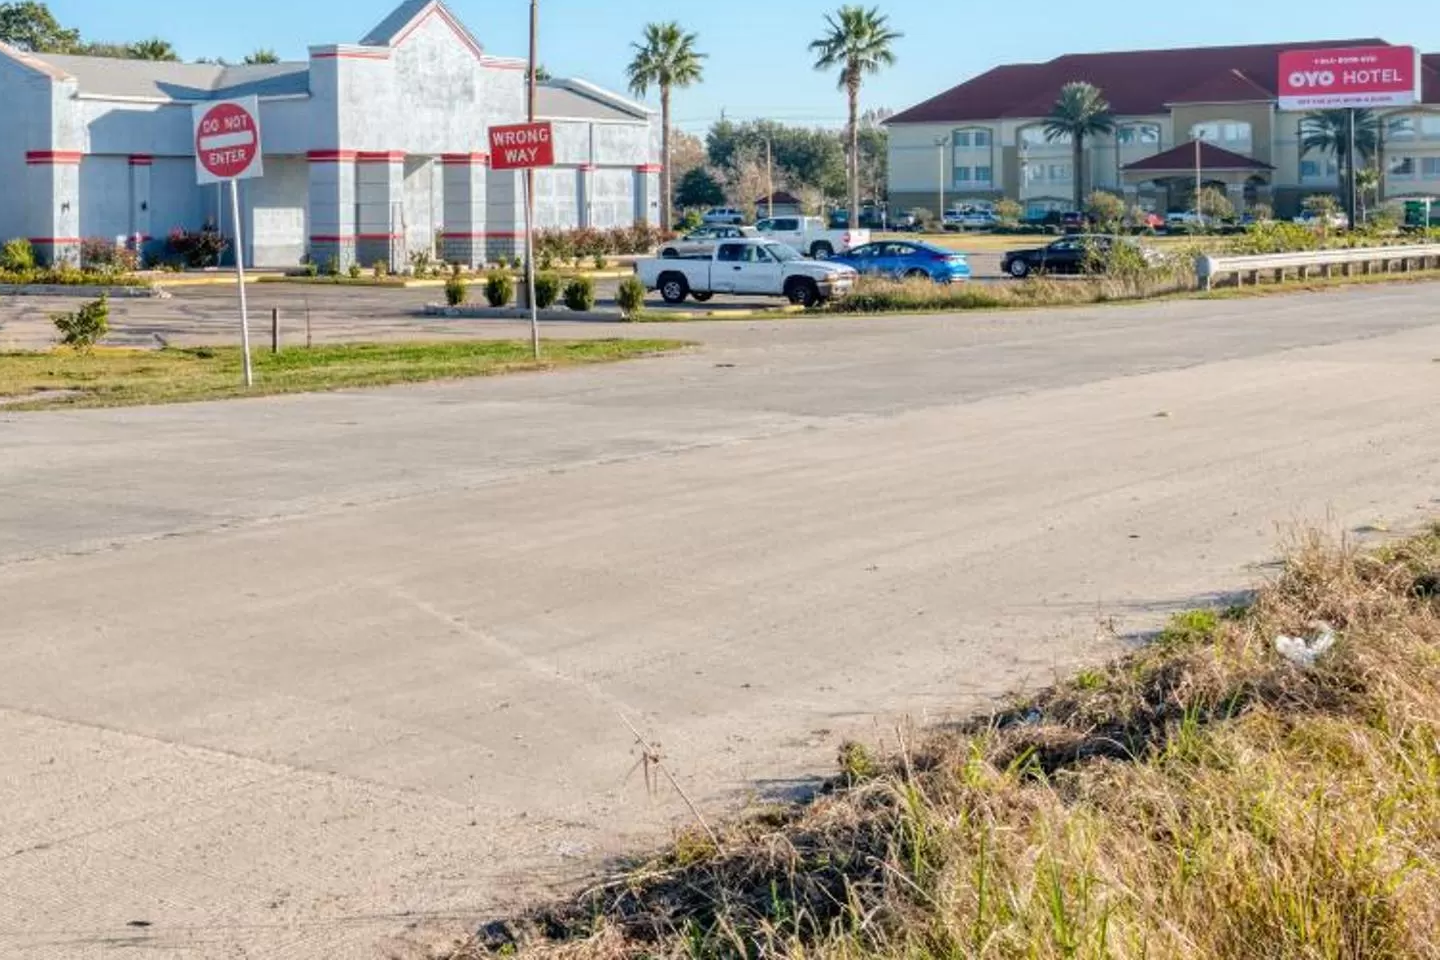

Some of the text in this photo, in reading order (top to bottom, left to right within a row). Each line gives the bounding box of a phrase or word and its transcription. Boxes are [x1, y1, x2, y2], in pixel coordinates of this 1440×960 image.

[1288, 68, 1403, 88] OYO HOTEL
[203, 114, 248, 133] DO NOT
[492, 127, 549, 147] WRONG
[210, 149, 246, 166] ENTER
[504, 147, 538, 163] WAY
